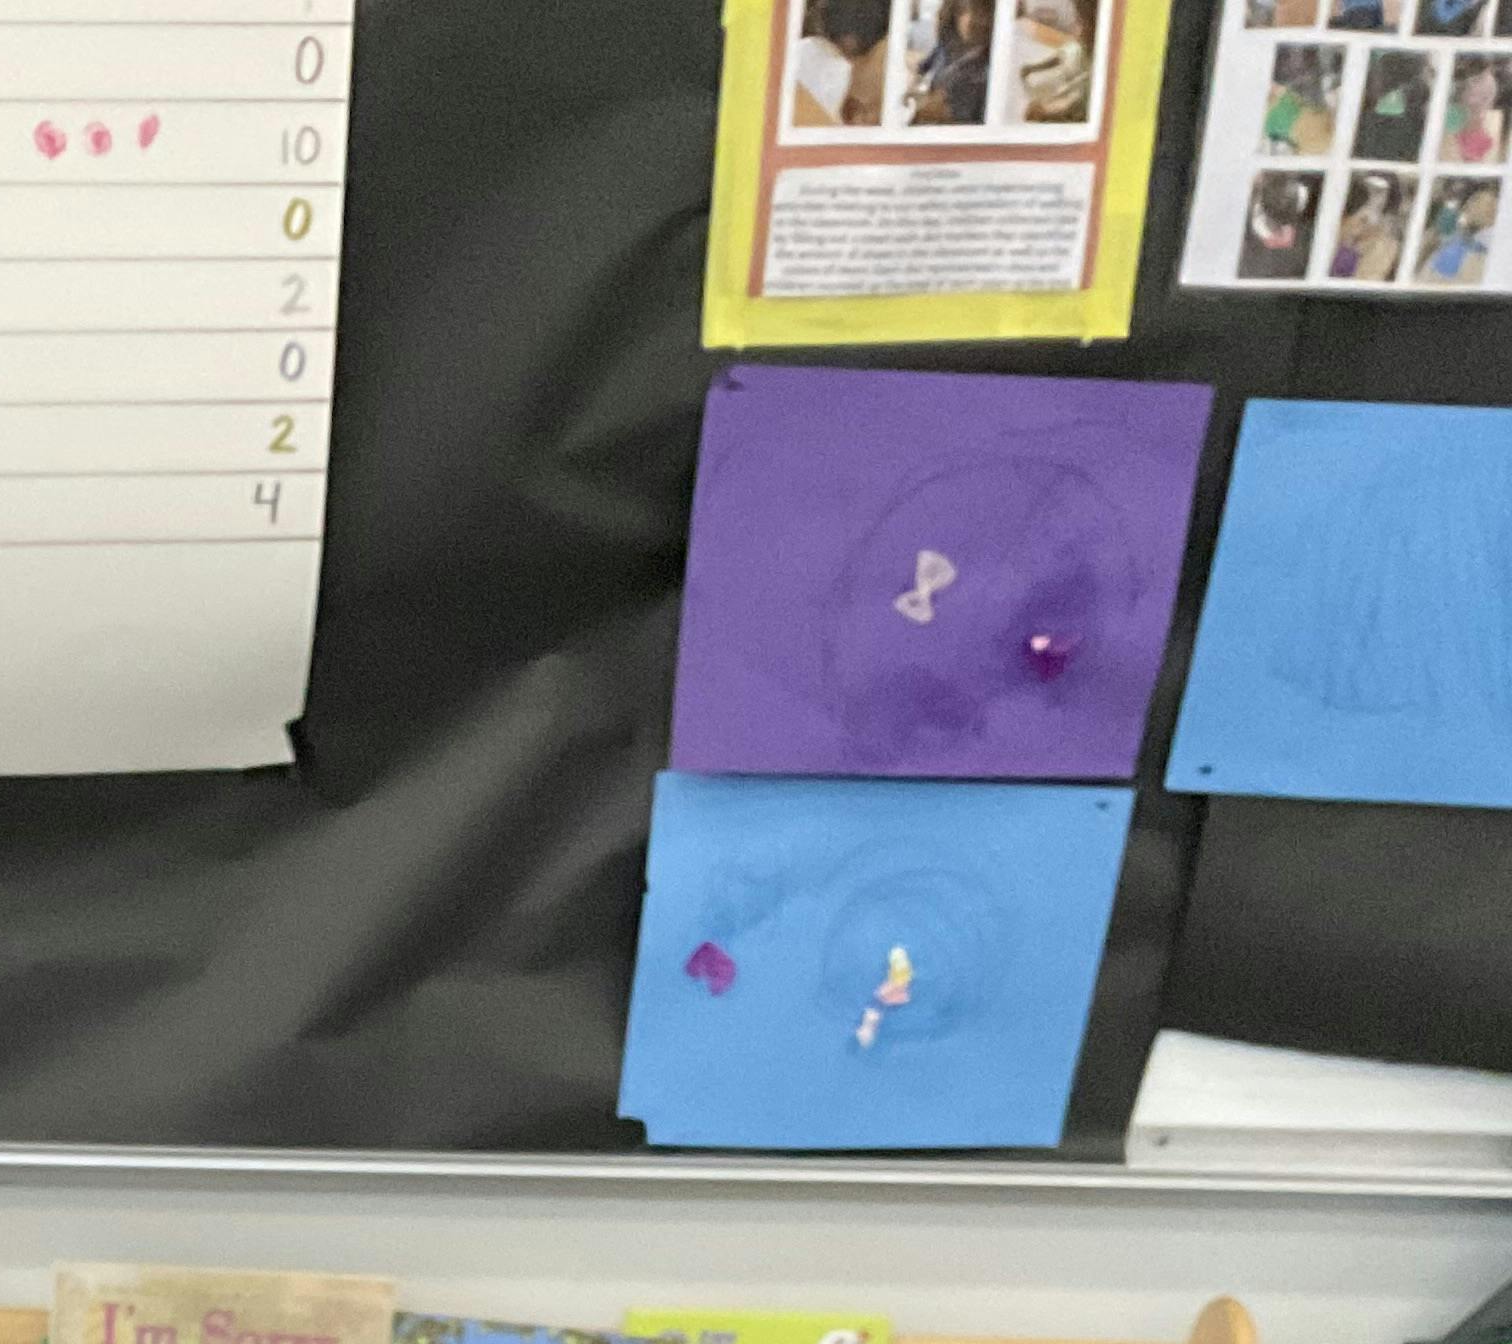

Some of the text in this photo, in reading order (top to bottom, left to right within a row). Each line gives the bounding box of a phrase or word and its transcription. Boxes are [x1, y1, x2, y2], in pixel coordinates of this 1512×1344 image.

[295, 35, 325, 85] 0
[282, 126, 321, 166] 10
[282, 197, 313, 241] 0
[279, 273, 311, 316] 2
[279, 341, 307, 382] 0
[268, 415, 297, 454] 2
[253, 481, 281, 525] 4
